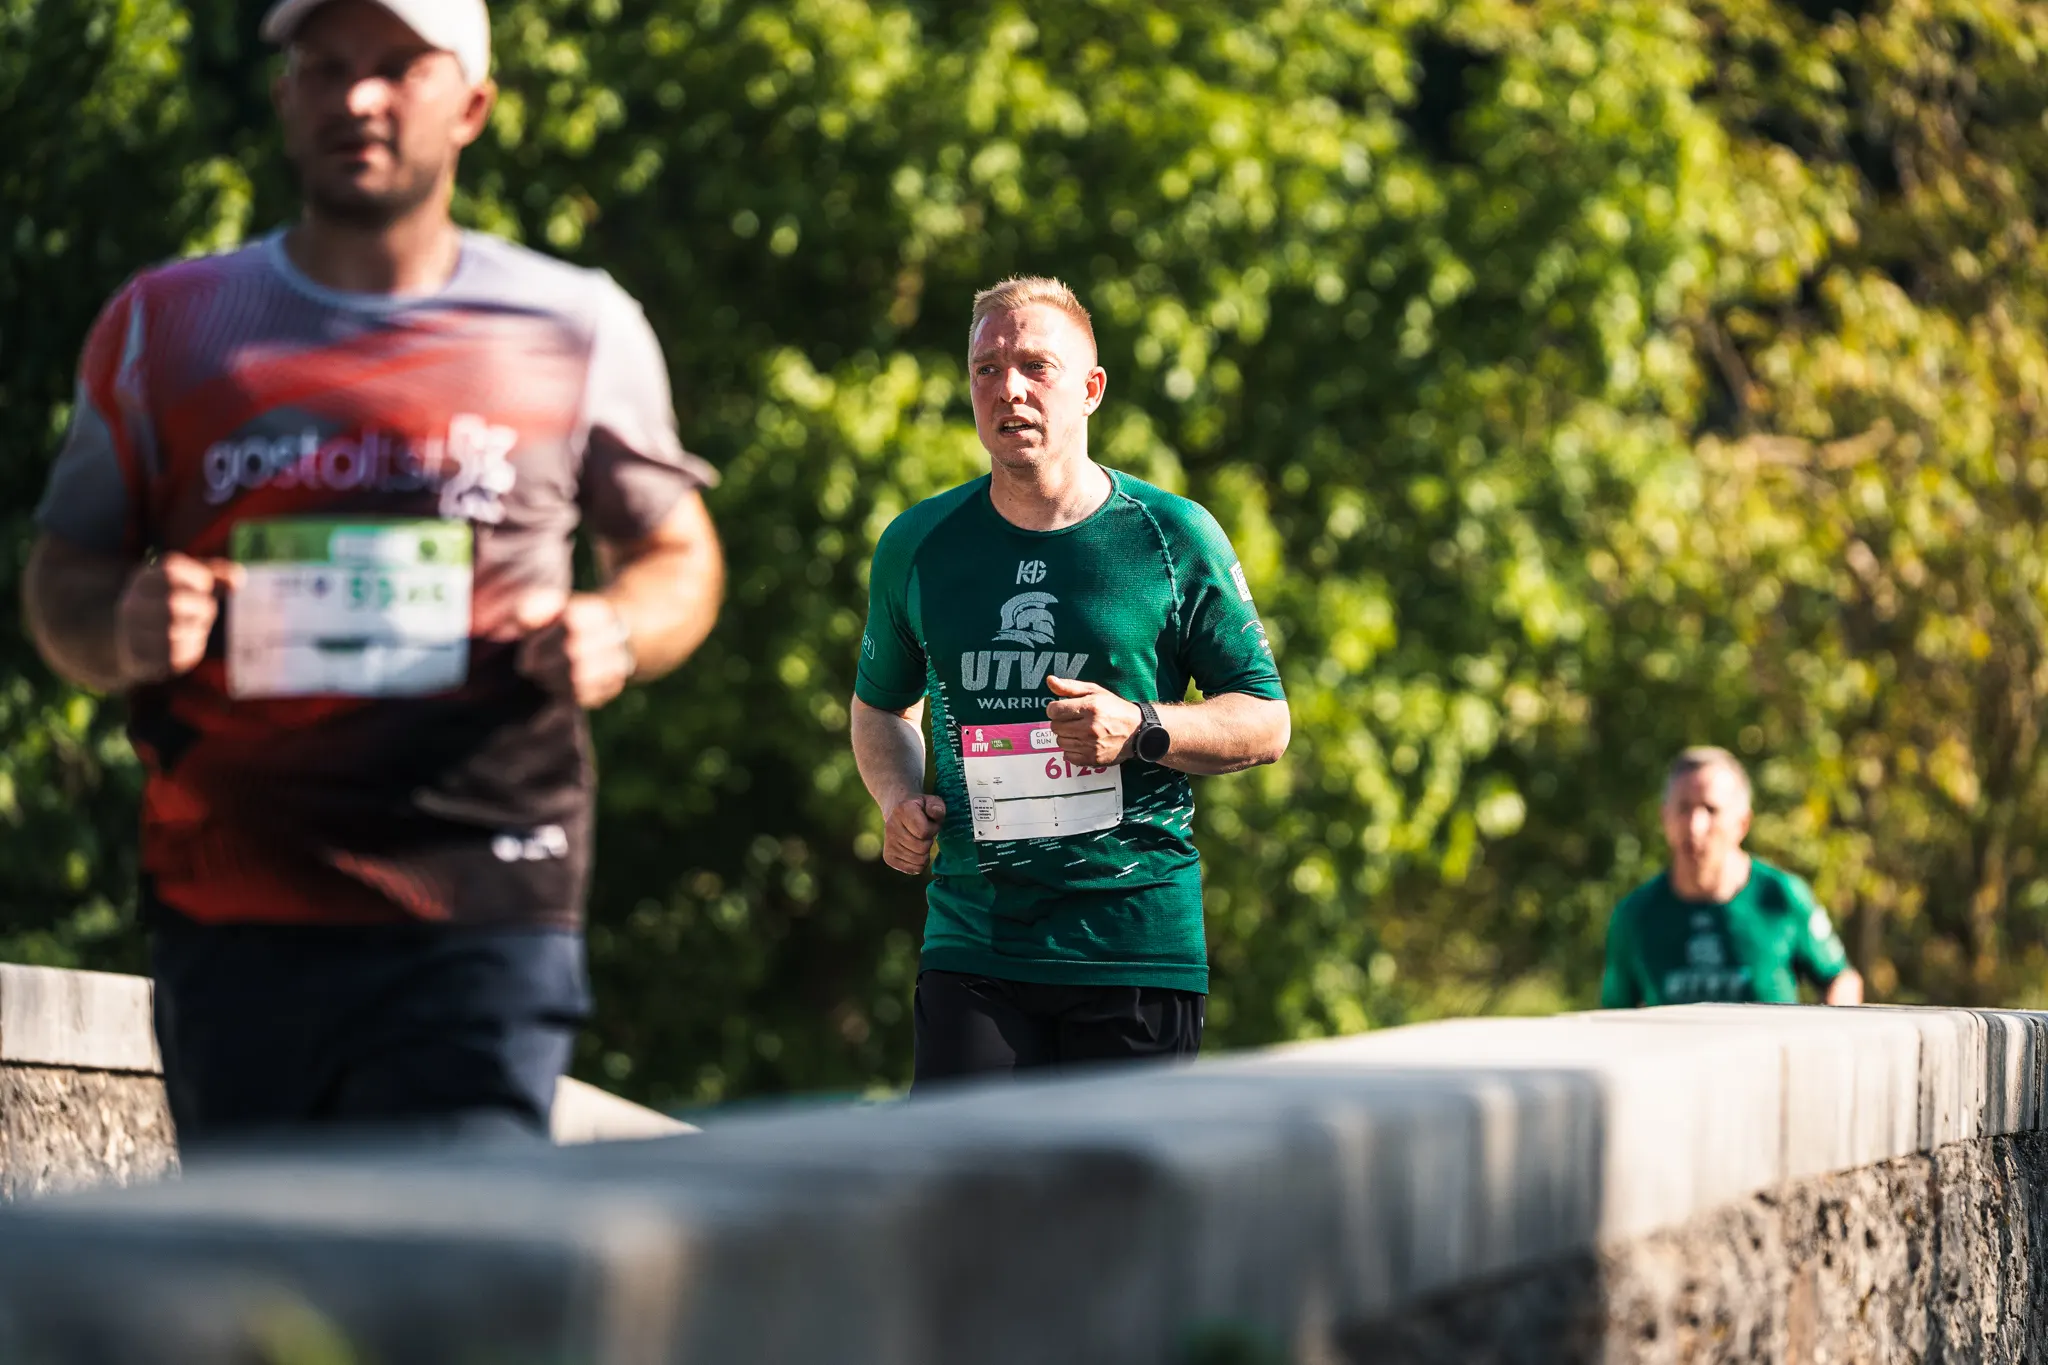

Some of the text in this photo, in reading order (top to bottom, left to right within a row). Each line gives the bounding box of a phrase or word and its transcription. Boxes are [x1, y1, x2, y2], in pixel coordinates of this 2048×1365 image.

[961, 651, 1089, 691] UTVV
[976, 697, 1067, 710] WARRIO
[971, 743, 989, 752] UTVV
